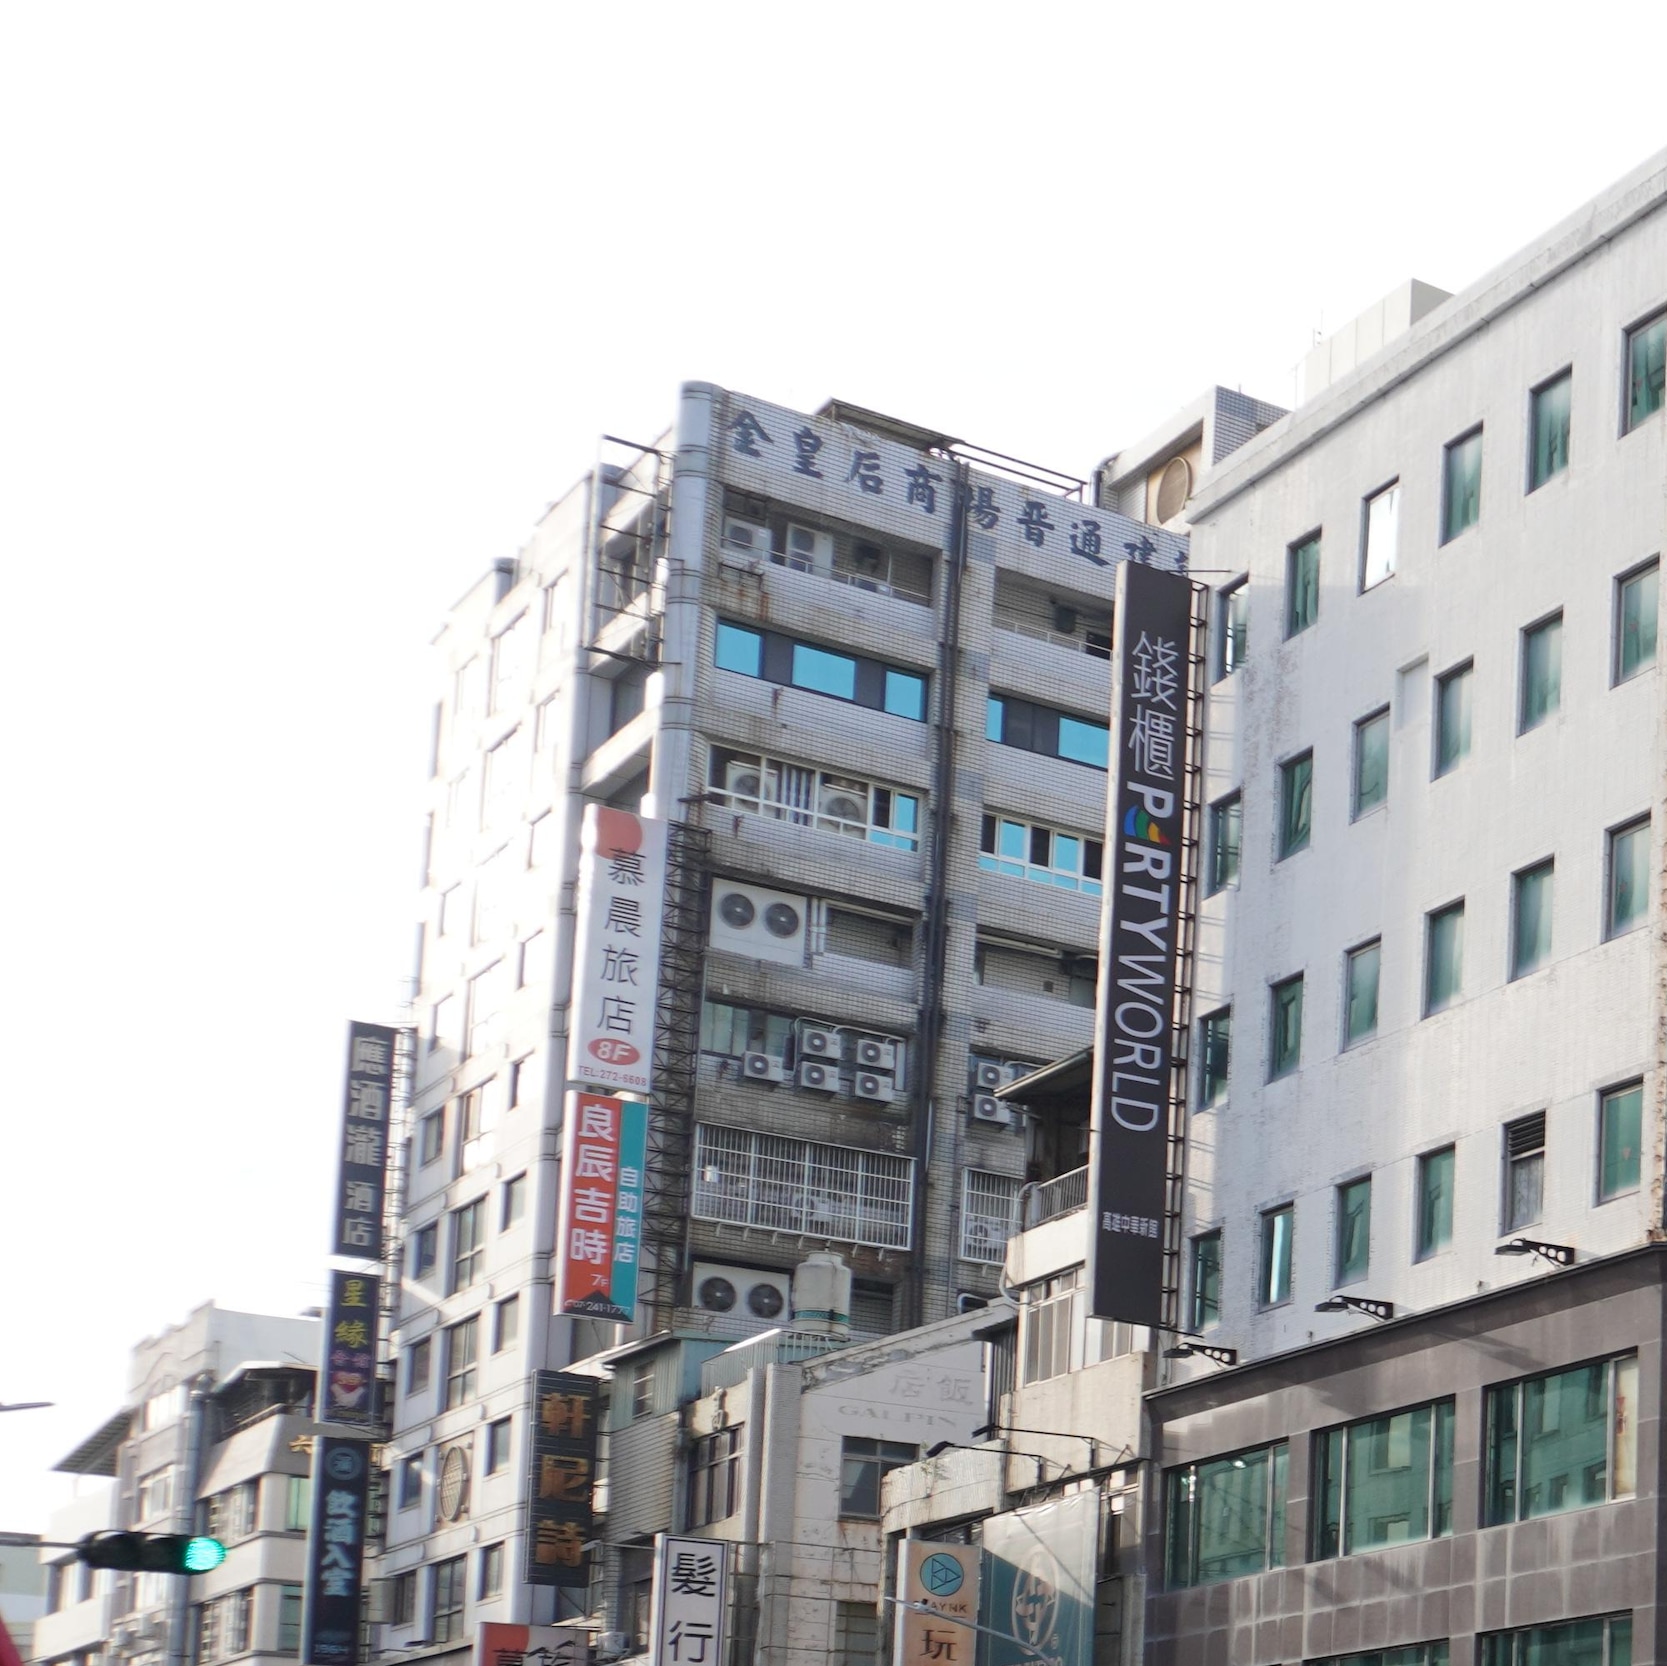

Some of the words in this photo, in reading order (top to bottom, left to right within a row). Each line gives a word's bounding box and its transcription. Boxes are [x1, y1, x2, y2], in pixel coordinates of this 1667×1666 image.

[1129, 631, 1178, 781] 錢櫃
[596, 843, 646, 1035] 慕晨旅店
[597, 1041, 630, 1061] 8F
[570, 1104, 616, 1265] 良辰吉時
[613, 1167, 638, 1263] 自助旅店
[668, 1553, 717, 1663] 髮行
